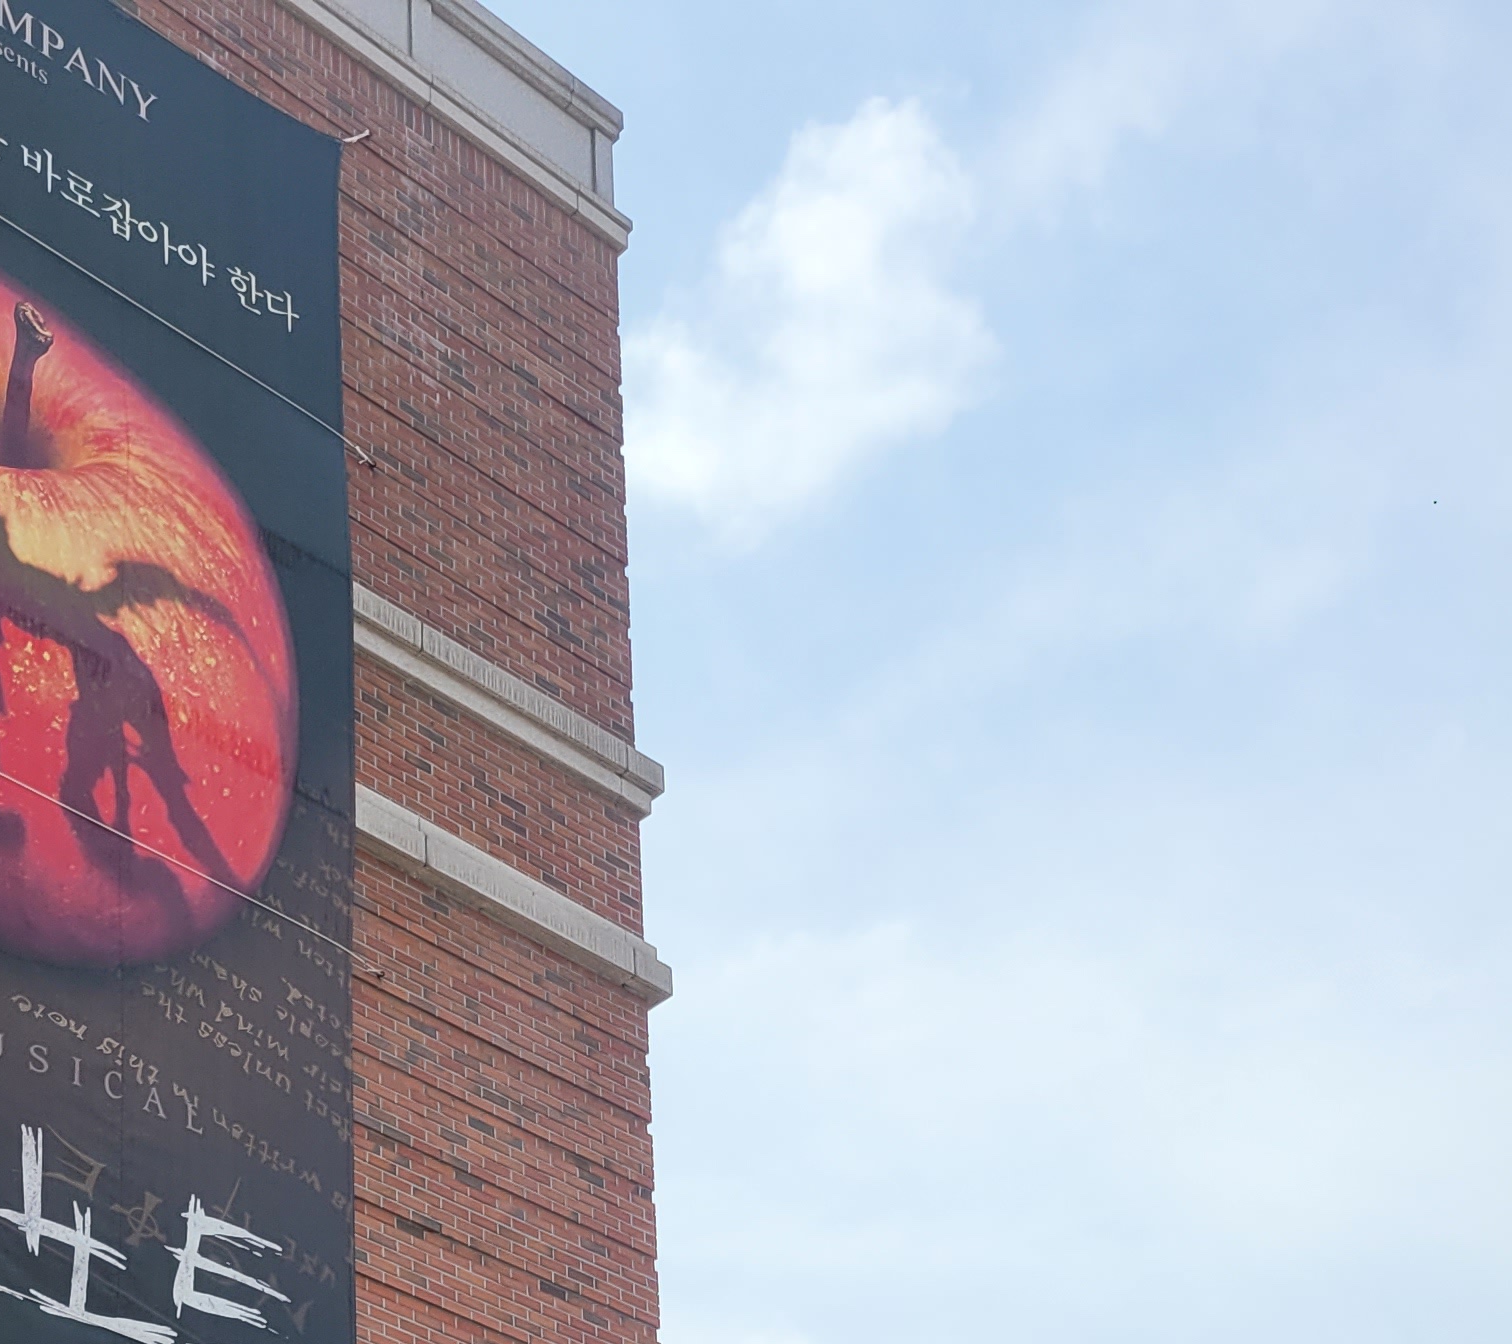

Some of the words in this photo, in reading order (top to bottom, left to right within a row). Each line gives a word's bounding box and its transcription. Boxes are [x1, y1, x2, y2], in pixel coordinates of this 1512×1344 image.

[20, 145, 216, 287] 바로잡아야
[226, 266, 300, 333] 한다
[7, 994, 88, 1040] note
[141, 980, 187, 1024] the
[217, 1000, 289, 1061] mind
[96, 1036, 161, 1085] this
[198, 1021, 291, 1093] unless
[211, 1106, 322, 1192] written
